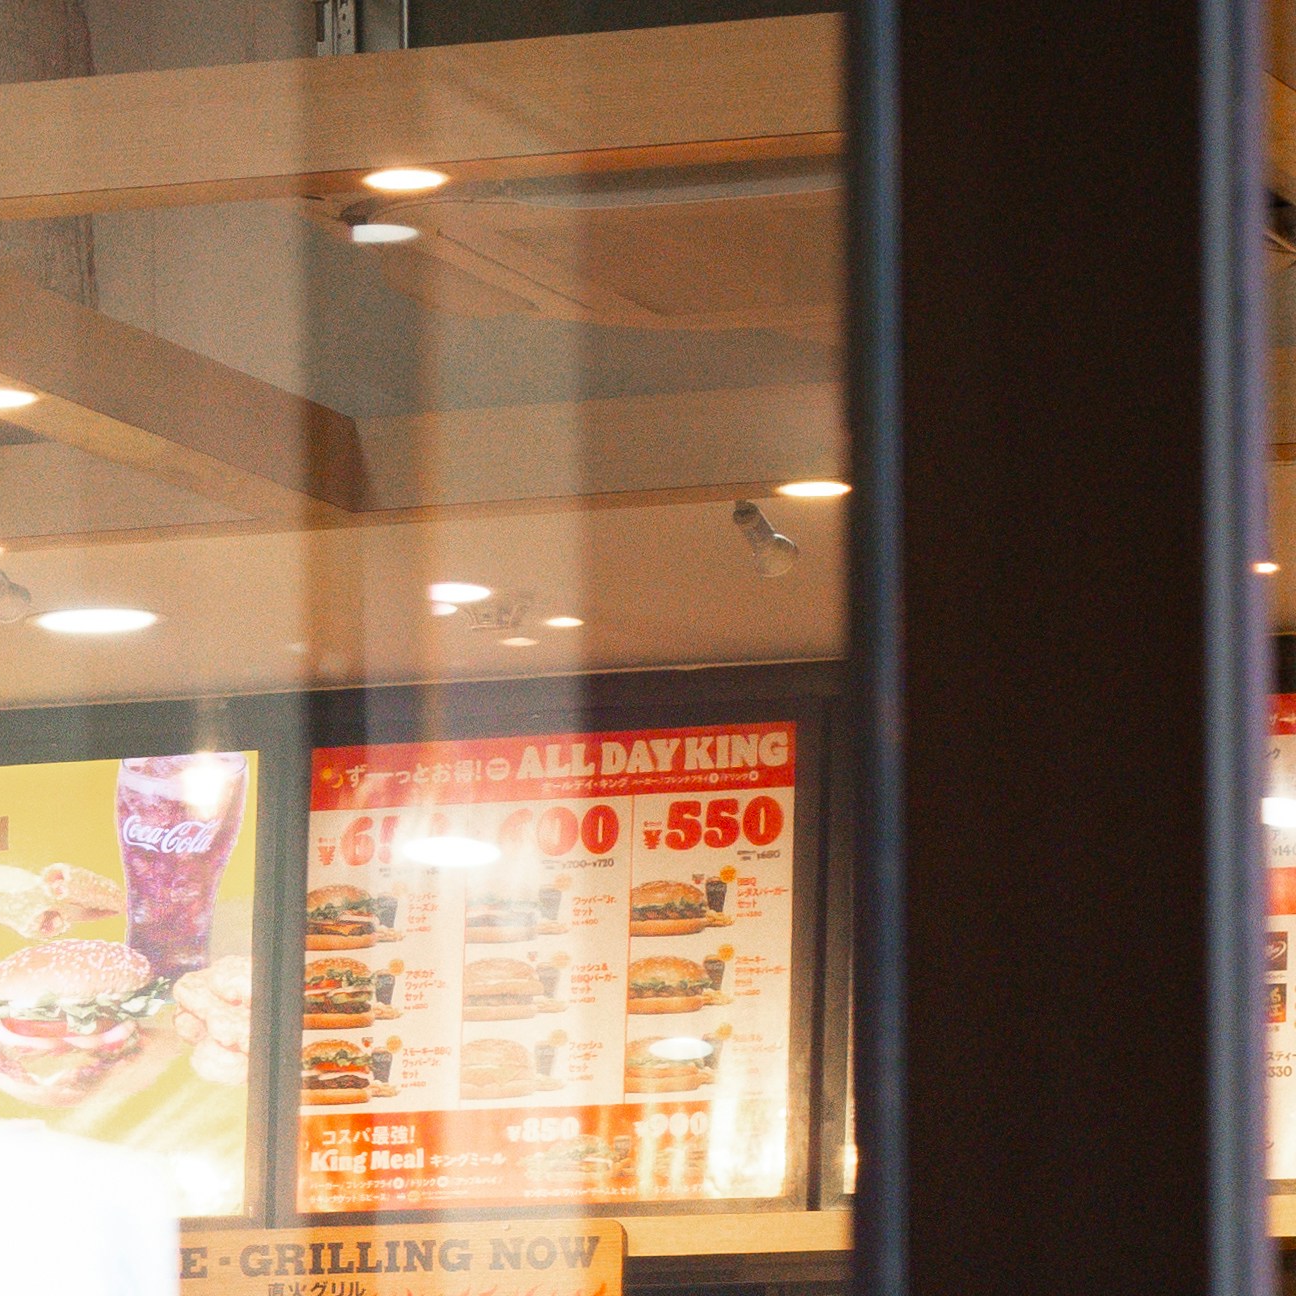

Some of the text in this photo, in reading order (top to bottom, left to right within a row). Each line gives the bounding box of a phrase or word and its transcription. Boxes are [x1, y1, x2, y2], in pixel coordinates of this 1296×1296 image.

[516, 731, 790, 780] ALL DAY KING
[122, 814, 221, 854] Coca-Cola
[643, 795, 785, 850] ¥550
[322, 1125, 416, 1146] コスパ最強!
[310, 1149, 368, 1174] King
[370, 1147, 425, 1170] Meal
[239, 1238, 474, 1277] GRILLING
[488, 1235, 602, 1271] NOW
